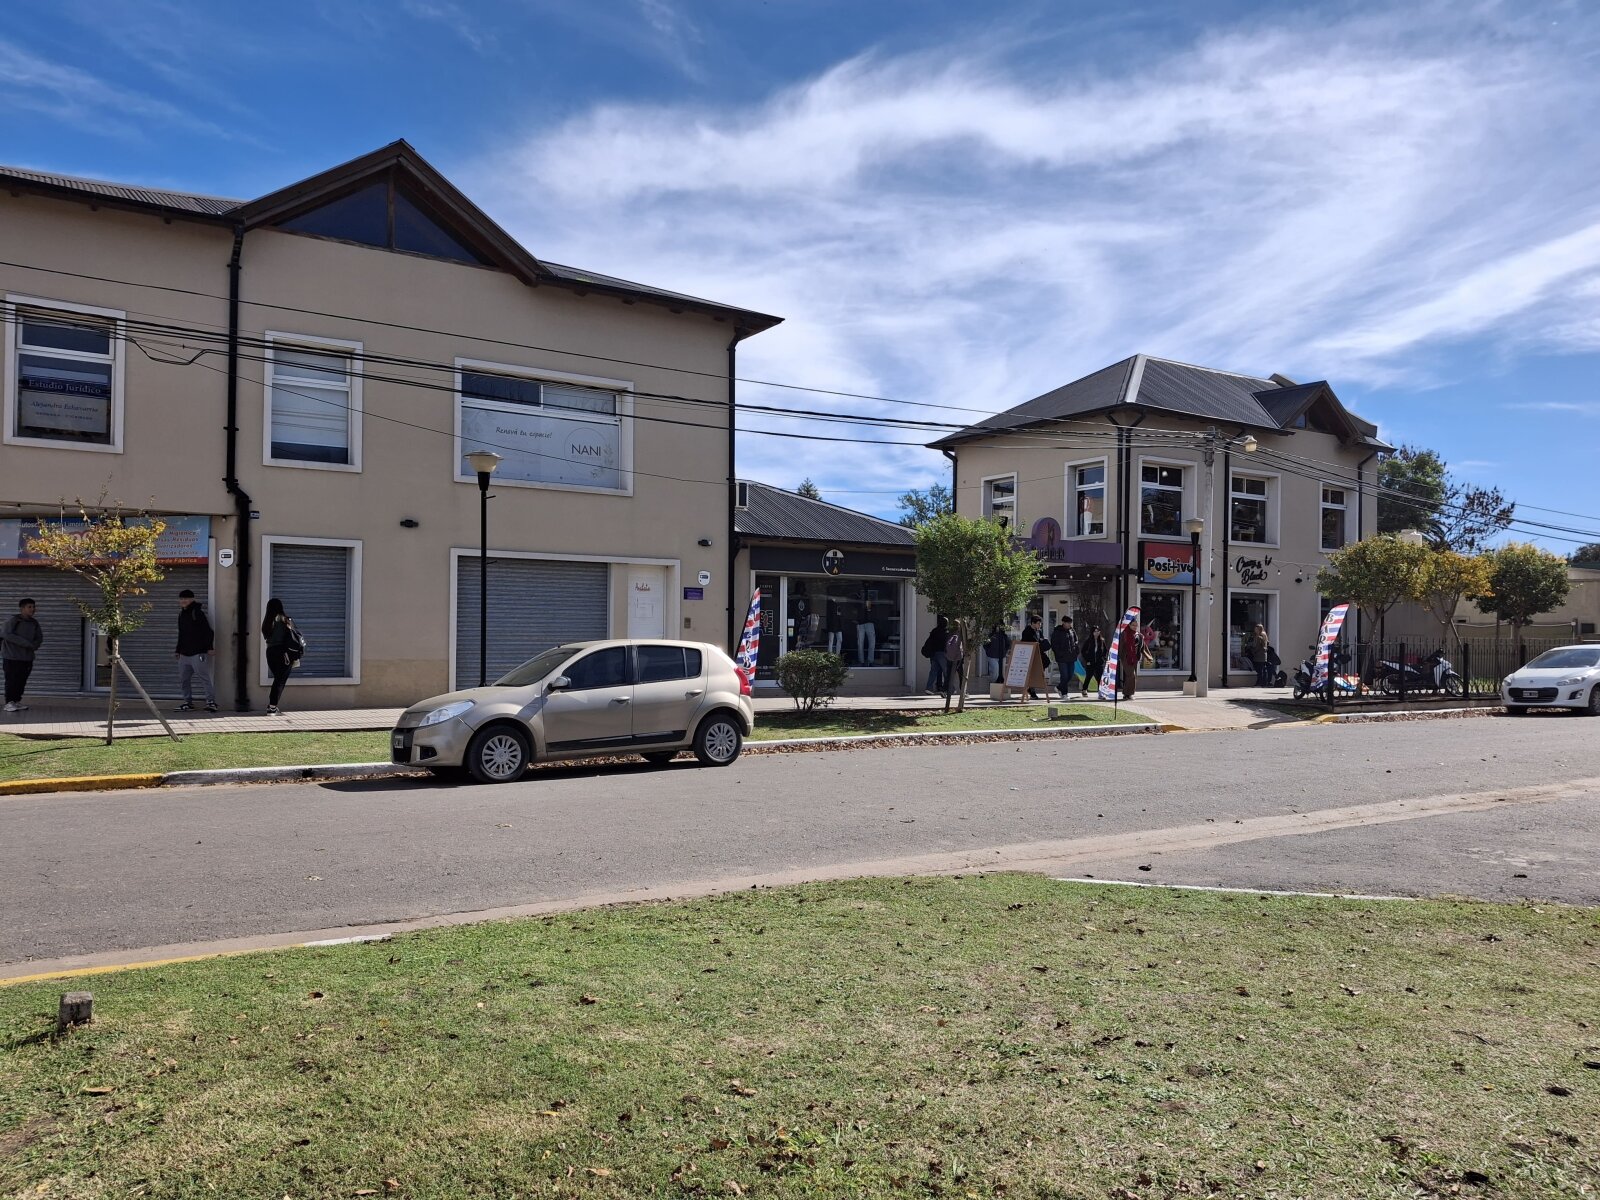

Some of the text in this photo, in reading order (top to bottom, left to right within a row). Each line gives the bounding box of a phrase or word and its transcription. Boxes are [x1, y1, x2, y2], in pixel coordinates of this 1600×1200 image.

[29, 379, 63, 390] Estudio
[571, 443, 601, 457] NANI
[1147, 557, 1193, 573] Positivo
[1241, 568, 1268, 585] Black
